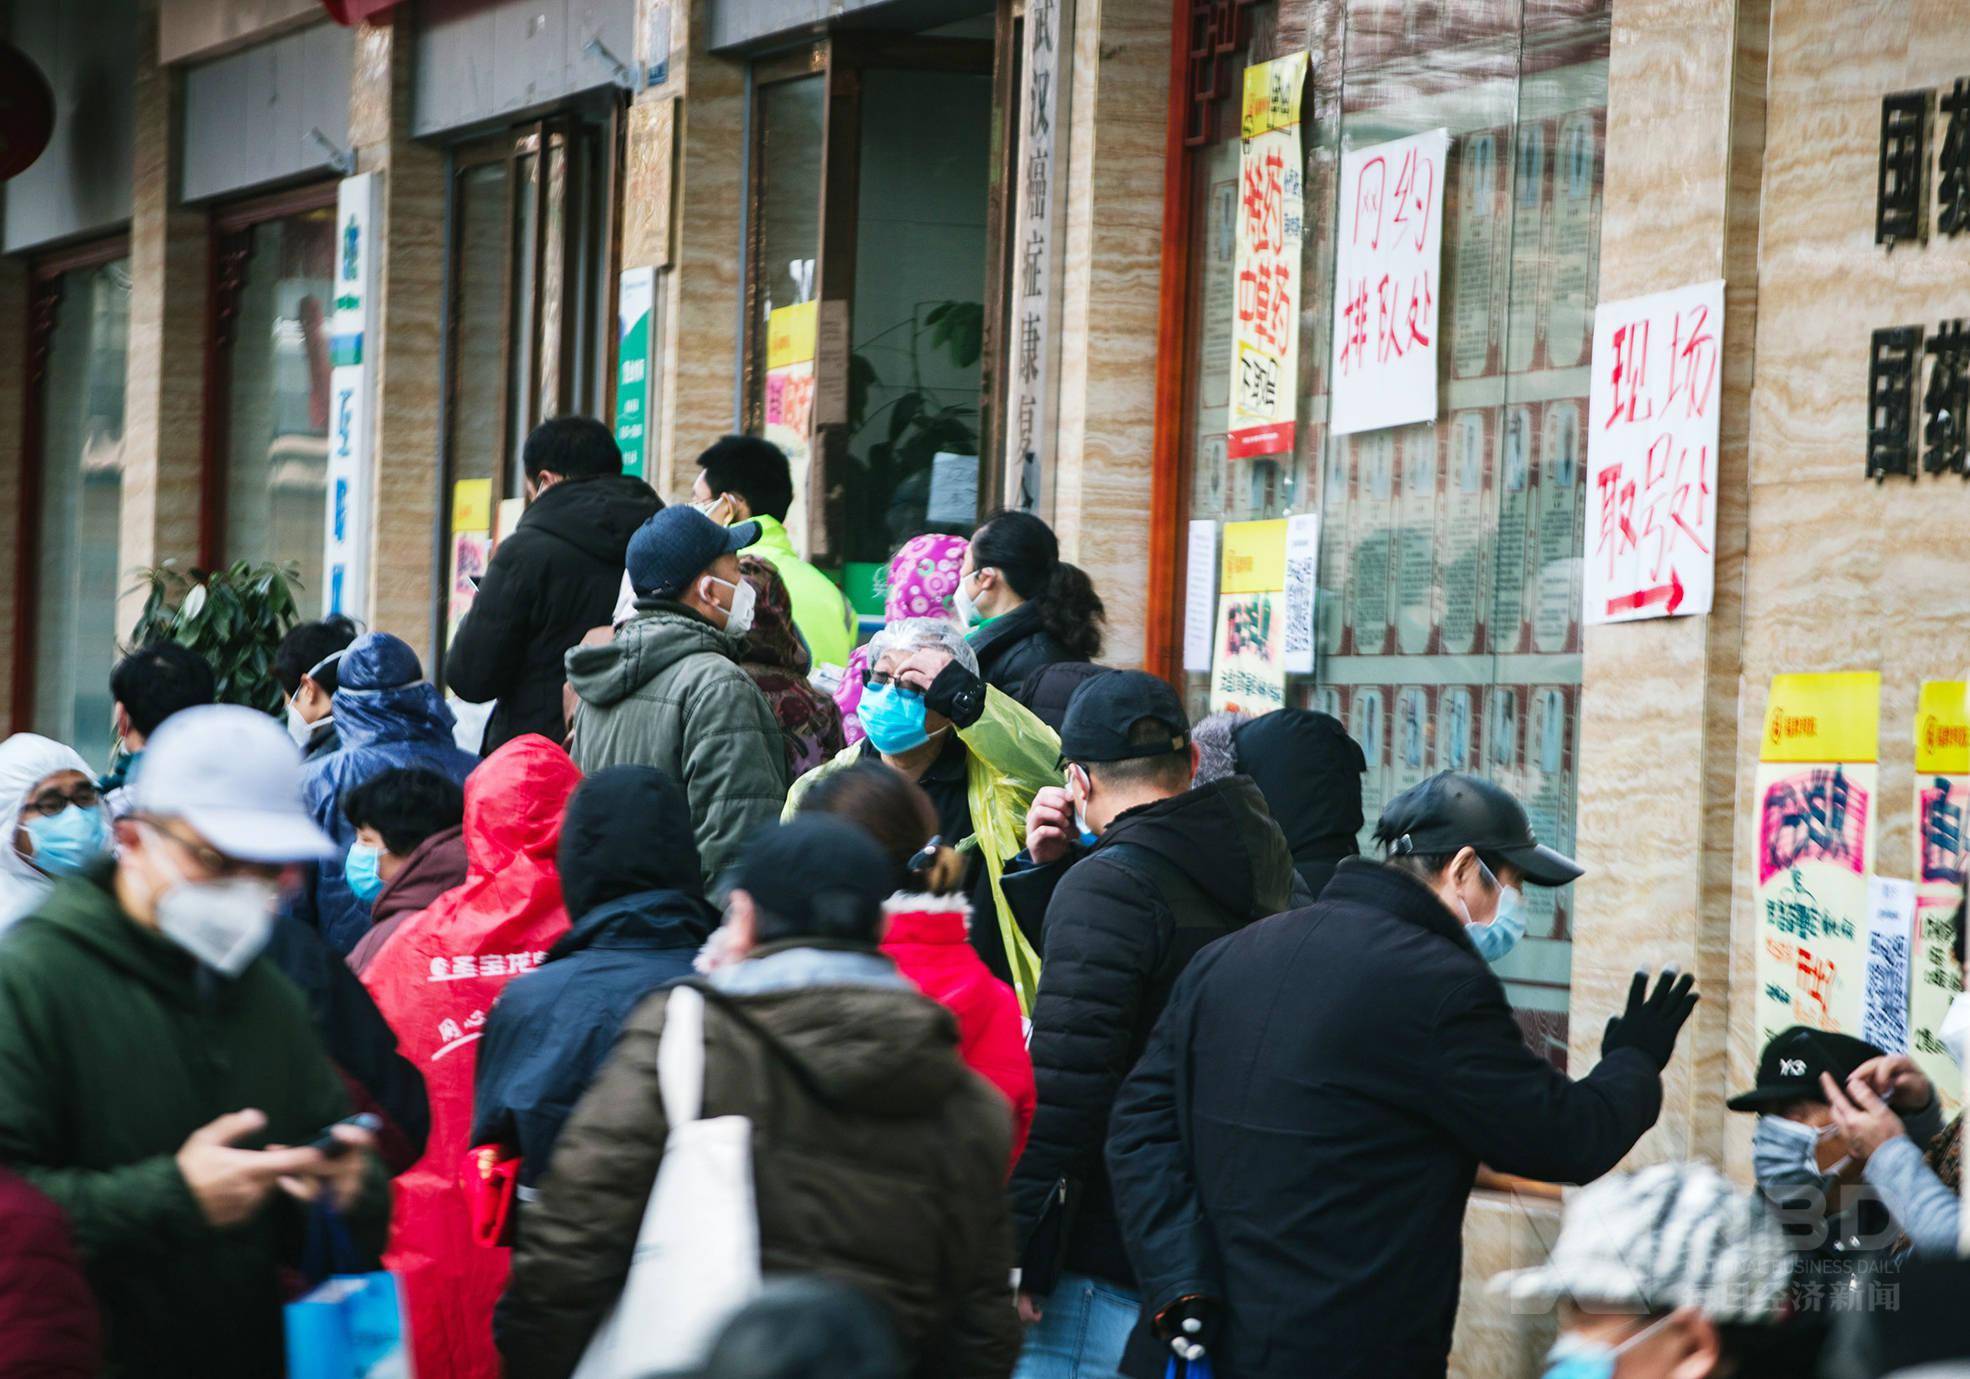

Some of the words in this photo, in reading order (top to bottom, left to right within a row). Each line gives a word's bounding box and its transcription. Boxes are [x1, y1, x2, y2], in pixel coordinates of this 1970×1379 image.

[1354, 144, 1433, 252] 网约
[1239, 261, 1290, 356] 中草药
[1340, 270, 1431, 376] 排队处
[1605, 304, 1716, 430] 现场
[1597, 432, 1709, 582] 取号处
